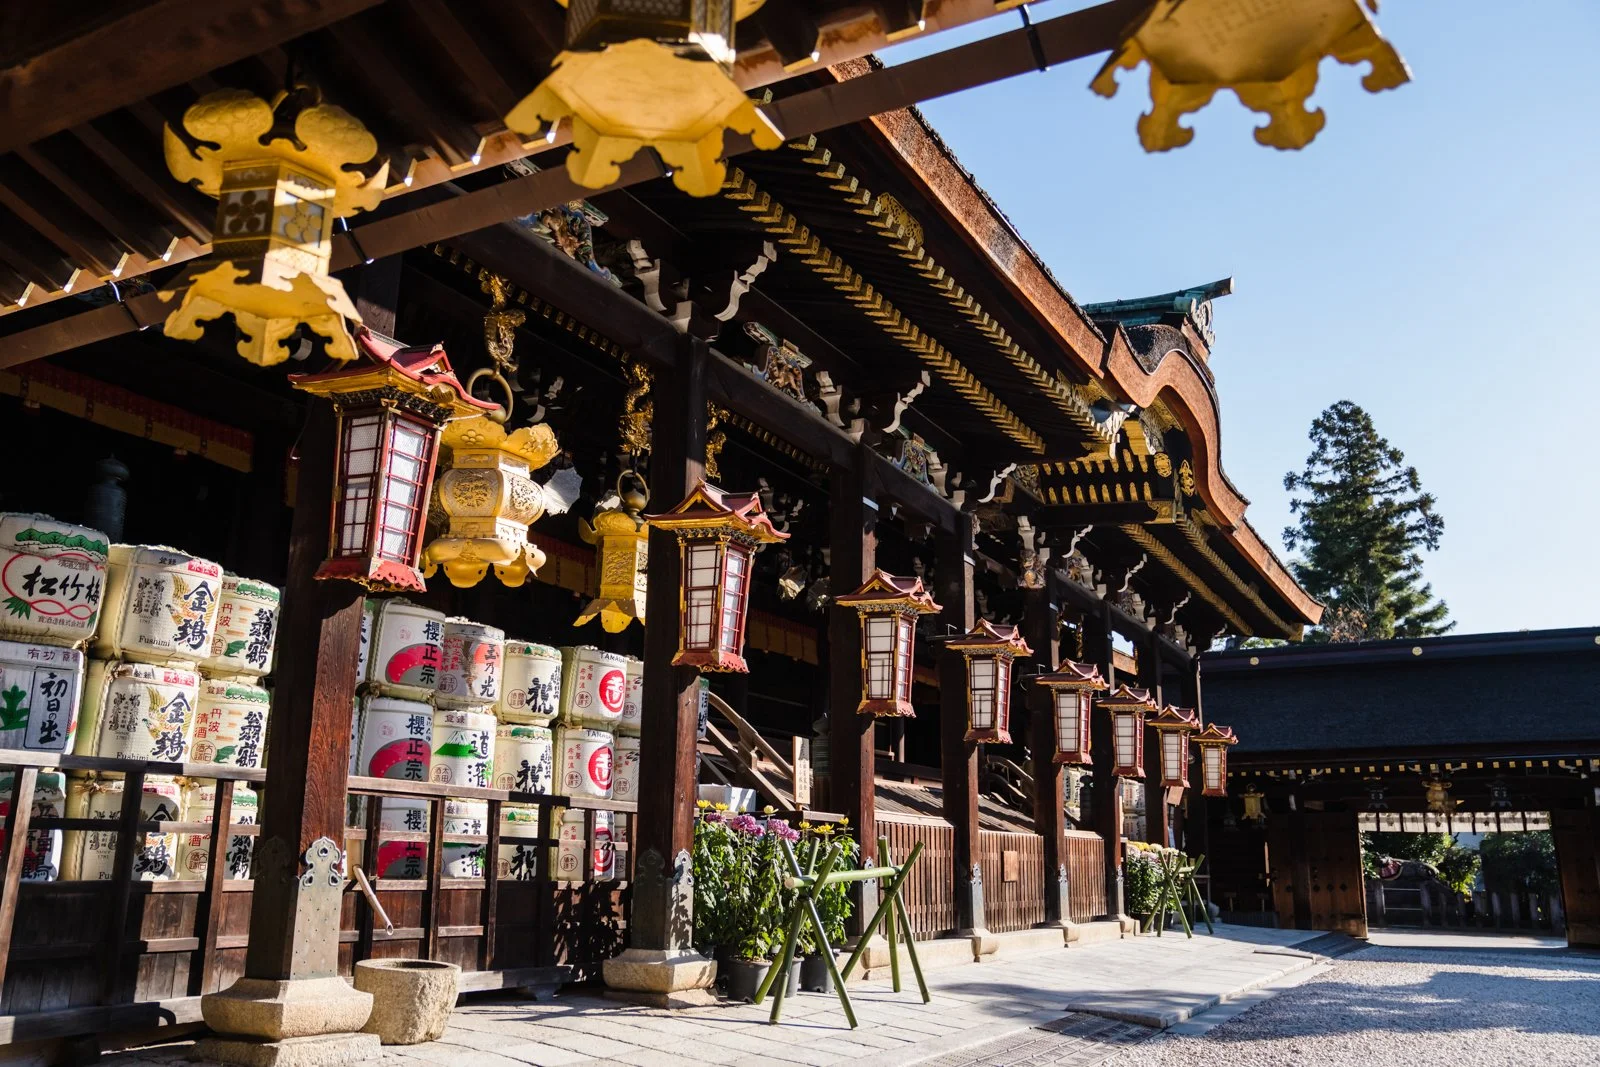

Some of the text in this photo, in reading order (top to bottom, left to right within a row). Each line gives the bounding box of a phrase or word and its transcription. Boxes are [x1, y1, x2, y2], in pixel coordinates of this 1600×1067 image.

[22, 565, 100, 605] 松竹梅
[28, 648, 55, 661] 有功
[138, 635, 171, 647] Fushimi
[420, 620, 440, 684] 櫻正宗
[480, 643, 499, 698] 玉乃光
[39, 672, 68, 745] 初日の出
[194, 713, 208, 738] 清酒
[208, 708, 222, 733] 丹波
[405, 714, 425, 780] 櫻正宗
